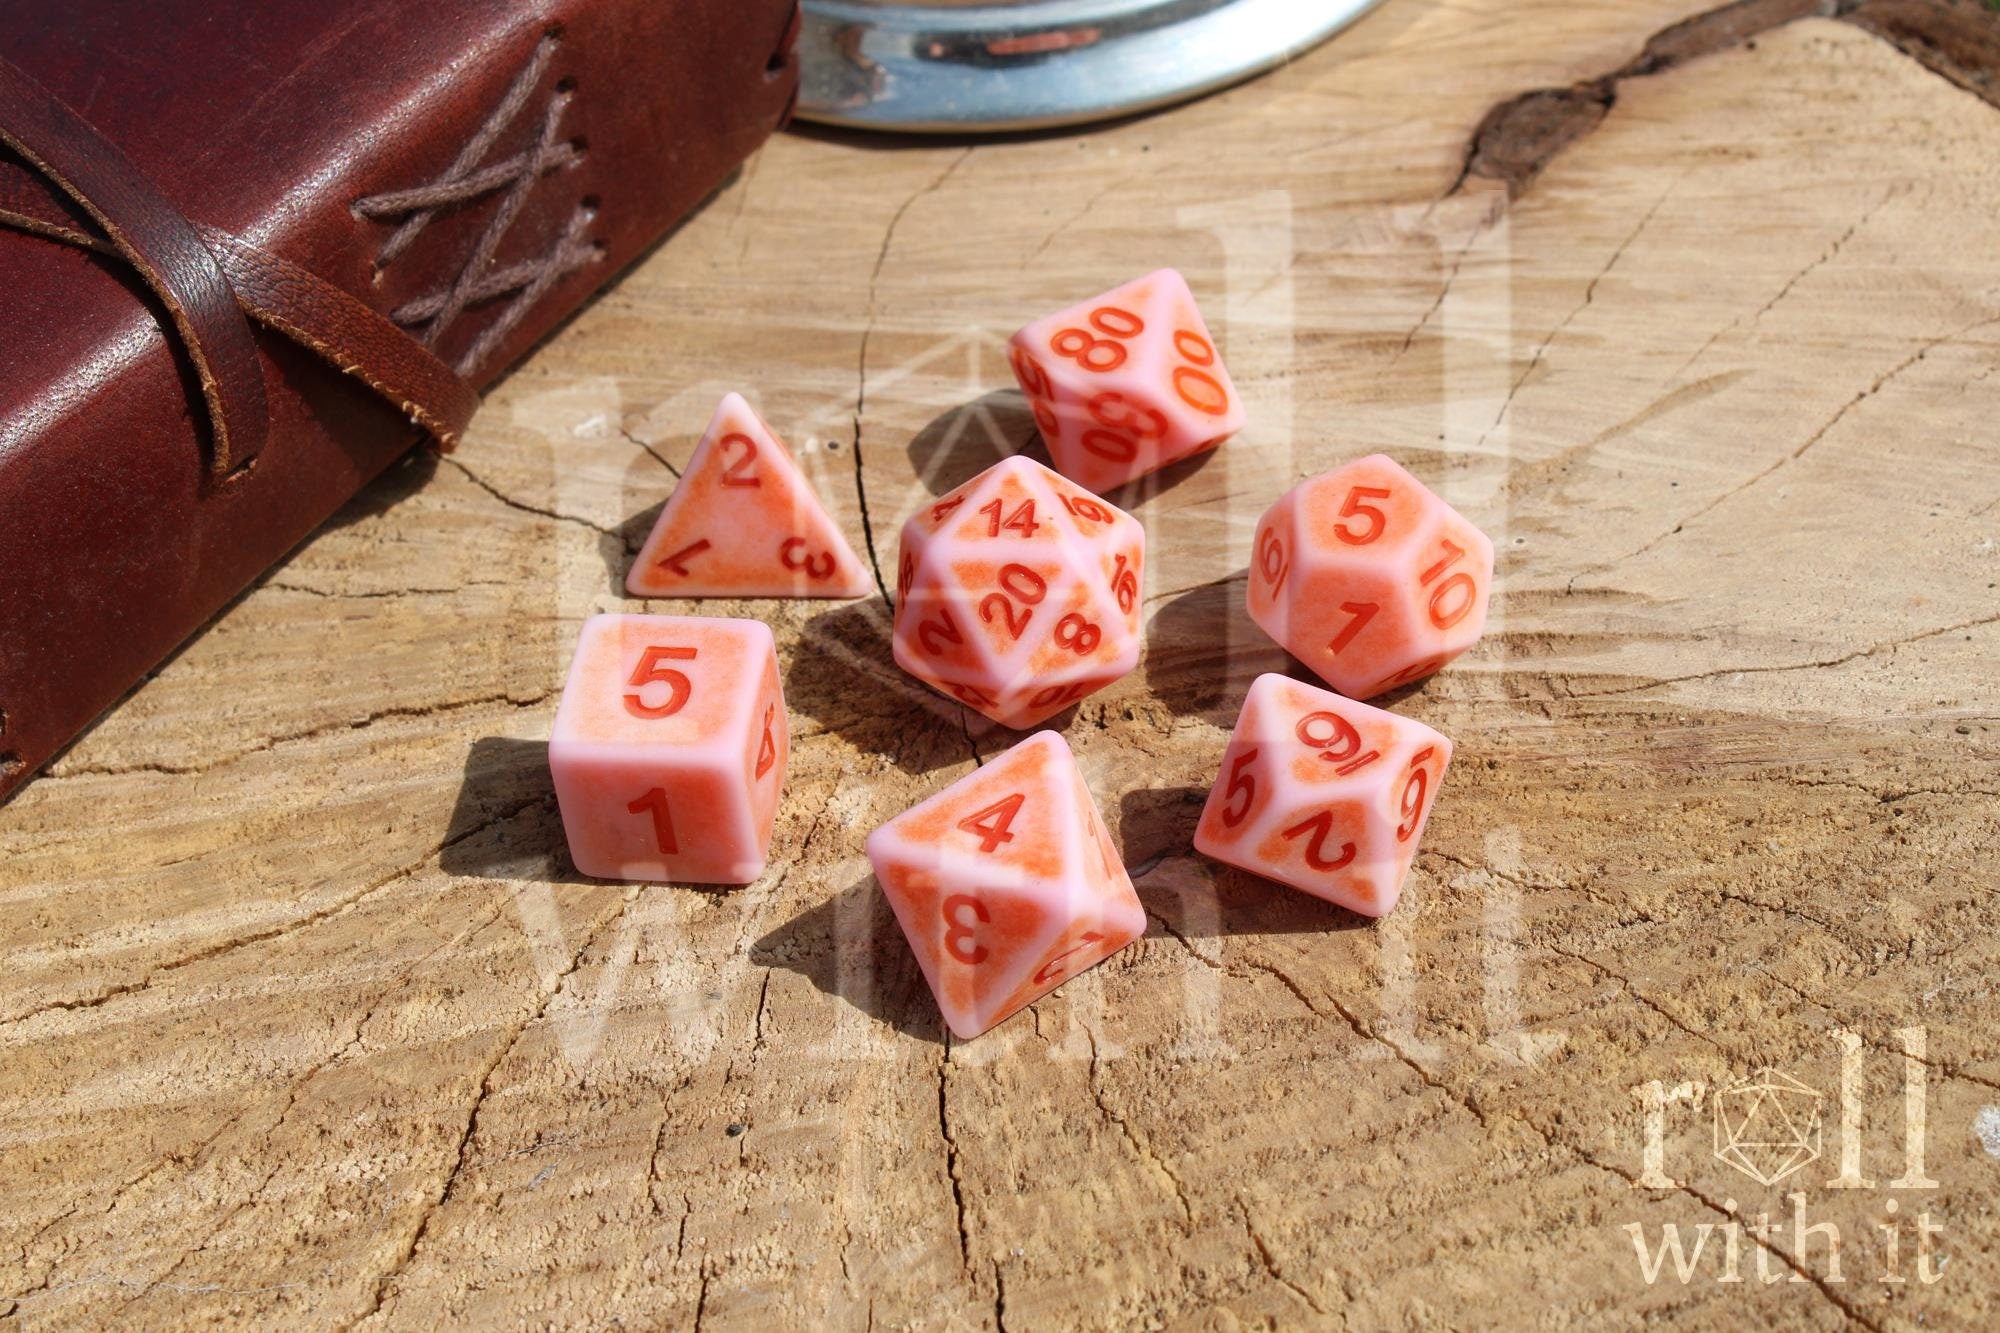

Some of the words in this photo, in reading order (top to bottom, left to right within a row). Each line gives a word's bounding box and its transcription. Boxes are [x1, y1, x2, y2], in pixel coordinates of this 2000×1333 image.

[1051, 307, 1144, 372] 80
[1173, 330, 1228, 415] 00
[1081, 392, 1168, 463] 30
[720, 433, 760, 488] 2
[979, 498, 1040, 538] 14
[1334, 486, 1391, 545] 5
[658, 539, 711, 576] 1
[779, 536, 836, 590] 3
[1111, 554, 1138, 615] 16
[1420, 539, 1476, 630] 10
[918, 608, 963, 656] 2
[979, 563, 1047, 640] 20
[1326, 602, 1380, 656] 1
[1054, 612, 1101, 657] 8
[623, 646, 698, 720] 5
[1222, 748, 1258, 828] 5
[627, 788, 679, 855] 1
[957, 793, 1026, 853] 4
[1281, 810, 1357, 873] 2
[942, 894, 991, 965] 3
